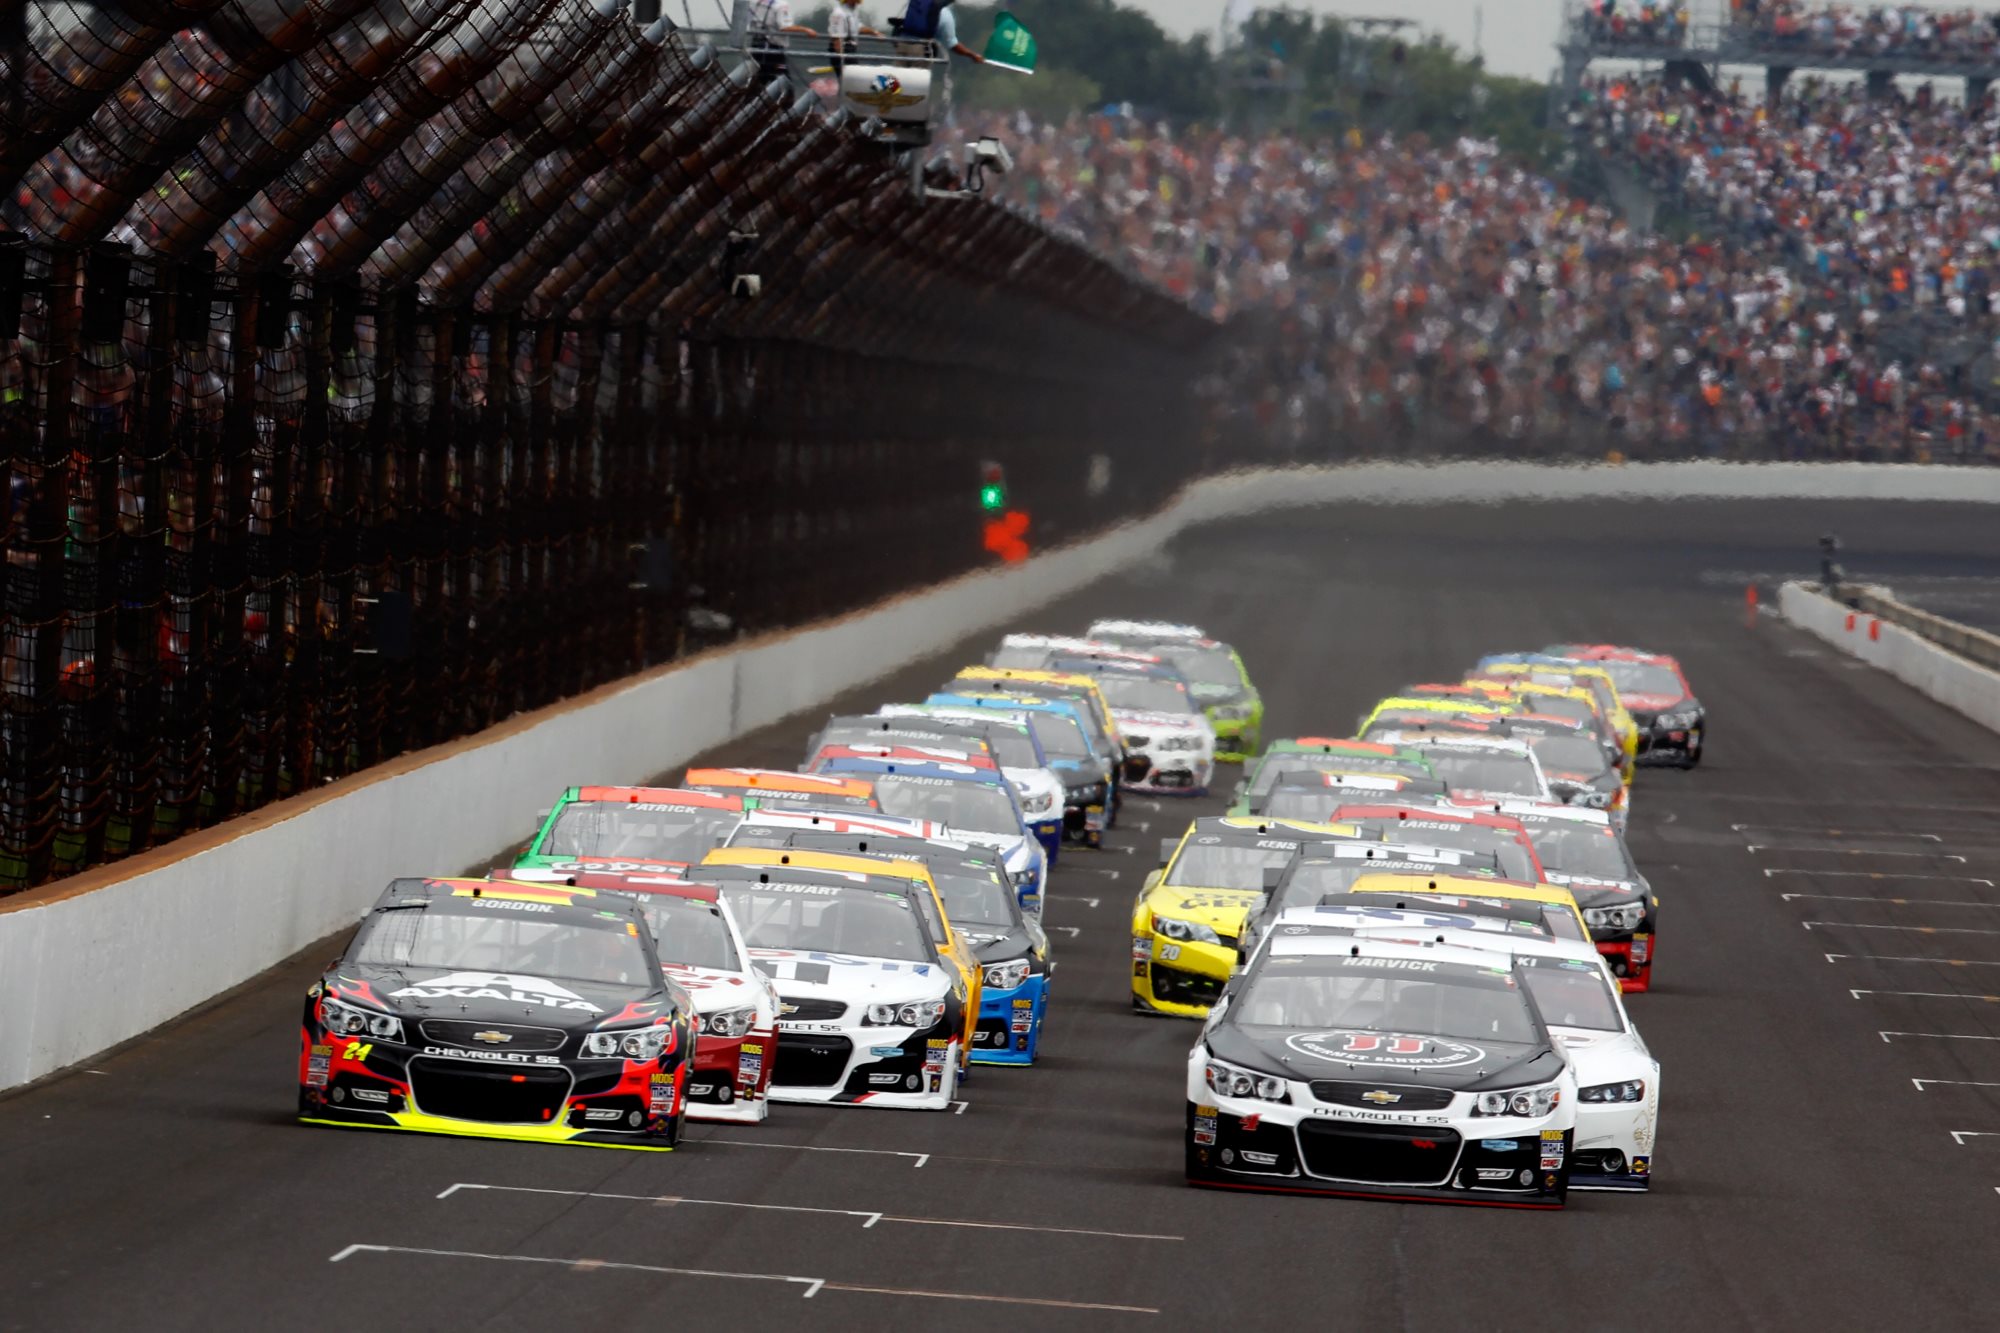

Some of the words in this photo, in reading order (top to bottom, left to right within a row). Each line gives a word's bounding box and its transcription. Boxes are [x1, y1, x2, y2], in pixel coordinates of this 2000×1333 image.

[879, 774, 954, 786] EDWARDS
[745, 788, 811, 800] BOWYER
[626, 803, 697, 814] PATRICK
[1398, 820, 1462, 832] LARSON
[1361, 859, 1436, 871] JOHNSON
[751, 882, 842, 895] STEWART
[471, 899, 553, 913] GORDON
[1160, 944, 1181, 960] 20
[1342, 957, 1438, 972] HARVICK
[387, 987, 605, 1013] AXALTA
[342, 1041, 373, 1061] 24
[423, 1046, 531, 1062] CHEVROLET
[535, 1055, 560, 1064] SS
[741, 1044, 763, 1054] MOOG
[651, 1073, 675, 1084] MOOG
[1239, 1113, 1264, 1131] 4
[1313, 1107, 1419, 1122] CHEVROLET
[1426, 1116, 1449, 1124] SS
[1541, 1130, 1564, 1141] MOOG
